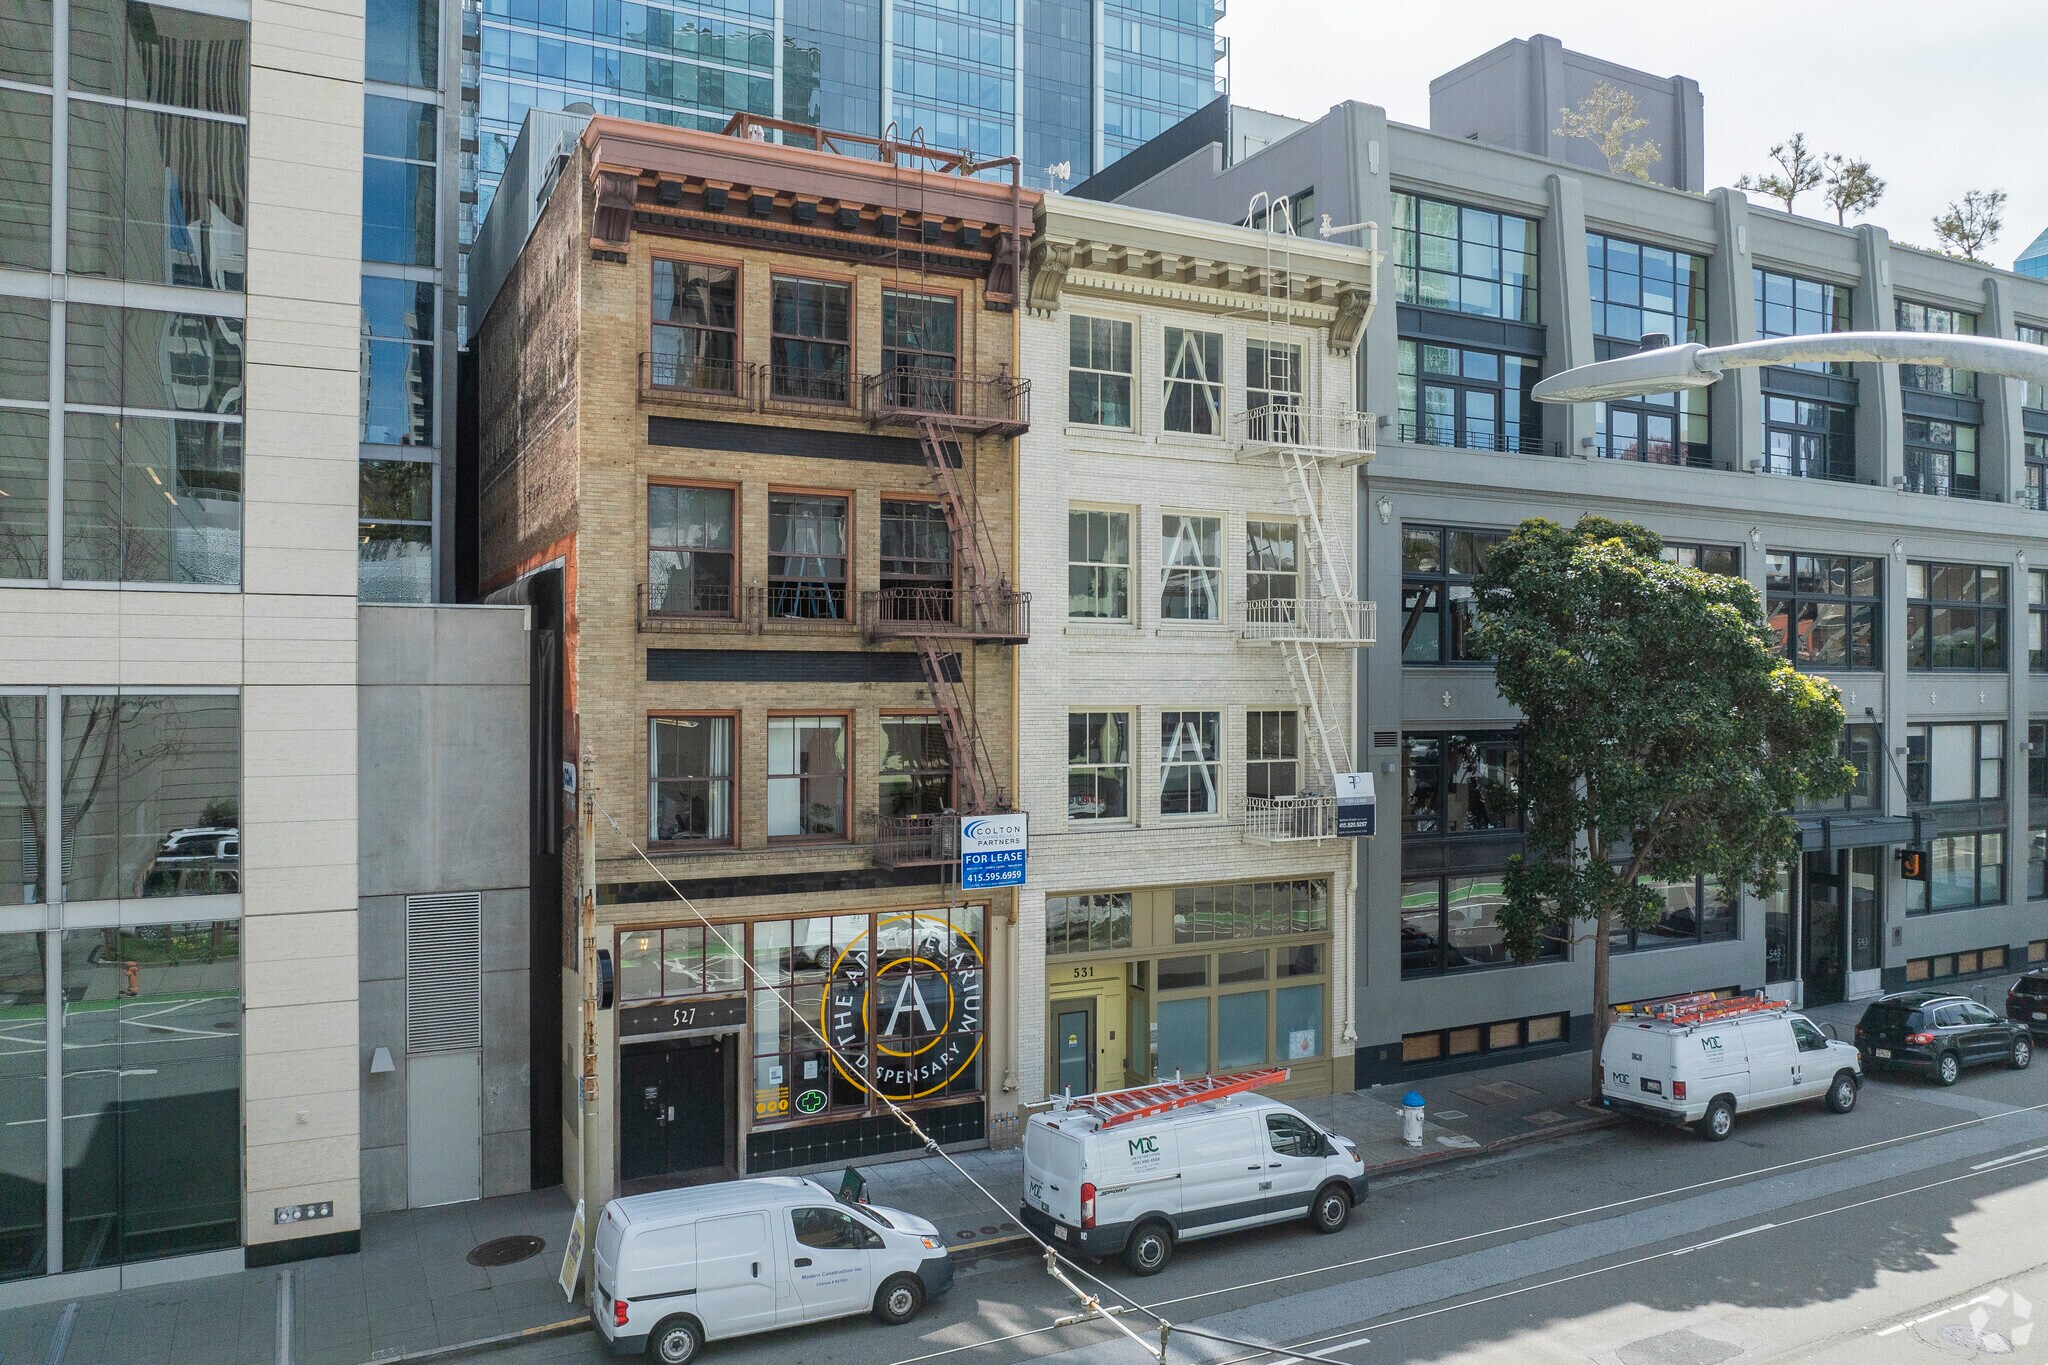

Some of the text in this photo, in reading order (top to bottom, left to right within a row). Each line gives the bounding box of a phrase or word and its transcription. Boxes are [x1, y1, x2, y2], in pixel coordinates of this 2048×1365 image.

[976, 826, 1021, 836] COLTON
[977, 837, 1021, 847] PARTNERS
[965, 851, 1023, 865] FOR LEASE
[967, 870, 1022, 883] 415.595.6959
[1857, 937, 1869, 947] 543
[1769, 948, 1781, 959] 543
[1073, 966, 1095, 979] 531
[884, 968, 937, 1036] A
[672, 1007, 697, 1027] 527
[834, 995, 856, 1049] THE
[1700, 1036, 1723, 1051] MDC
[855, 1042, 961, 1084] DSPENSARY
[1612, 1071, 1630, 1085] MDC
[1128, 1135, 1160, 1156] MDC
[1098, 1187, 1130, 1197] SPORT
[822, 1268, 854, 1276] Construction
